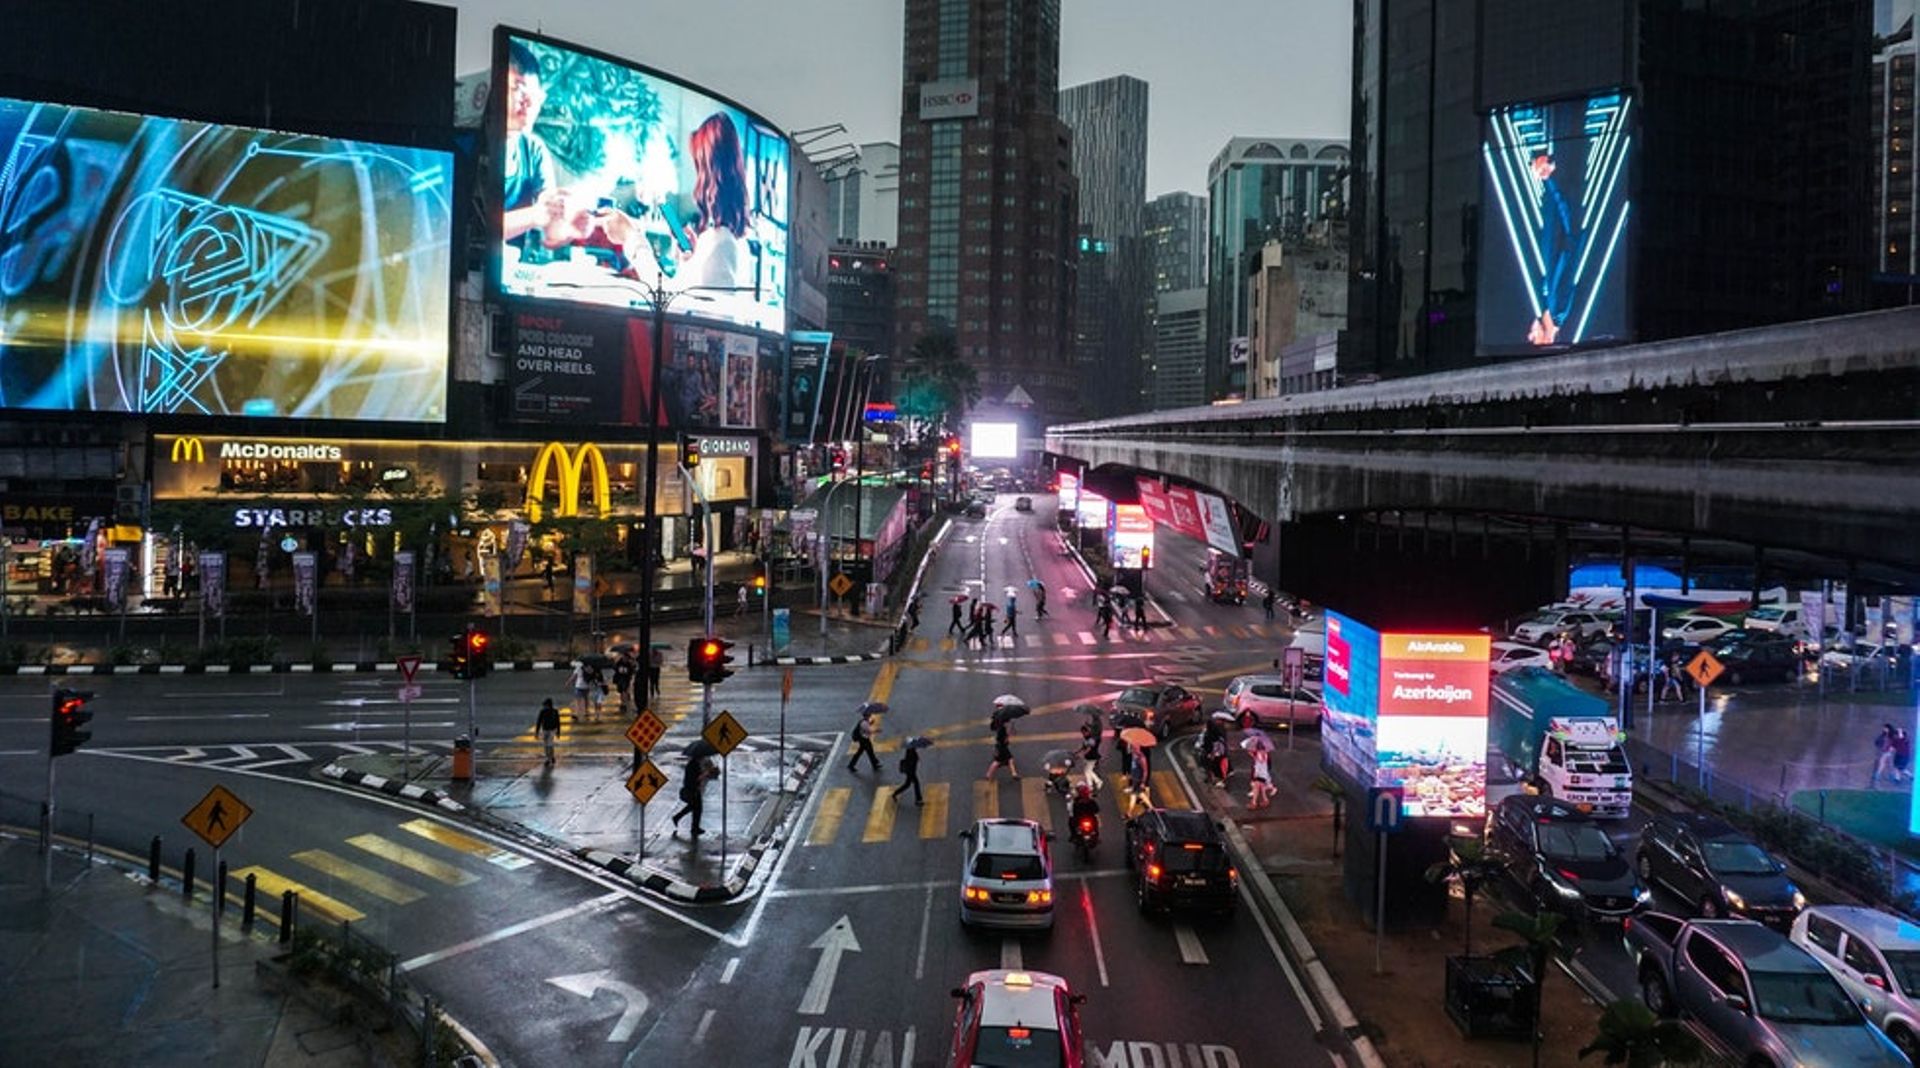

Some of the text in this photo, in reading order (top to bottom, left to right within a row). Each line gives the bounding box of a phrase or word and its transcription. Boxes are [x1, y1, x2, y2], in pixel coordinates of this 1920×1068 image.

[923, 94, 954, 107] HSBC
[517, 329, 594, 347] FOR CHOICE
[517, 344, 583, 361] AND HEAD
[516, 358, 596, 375] OVER HEELS.
[220, 442, 342, 460] McDonald's
[700, 438, 751, 454] GIORDANO
[3, 504, 74, 520] BAKE
[235, 508, 393, 528] STARBUCKS
[1392, 684, 1473, 704] Azerbaijan
